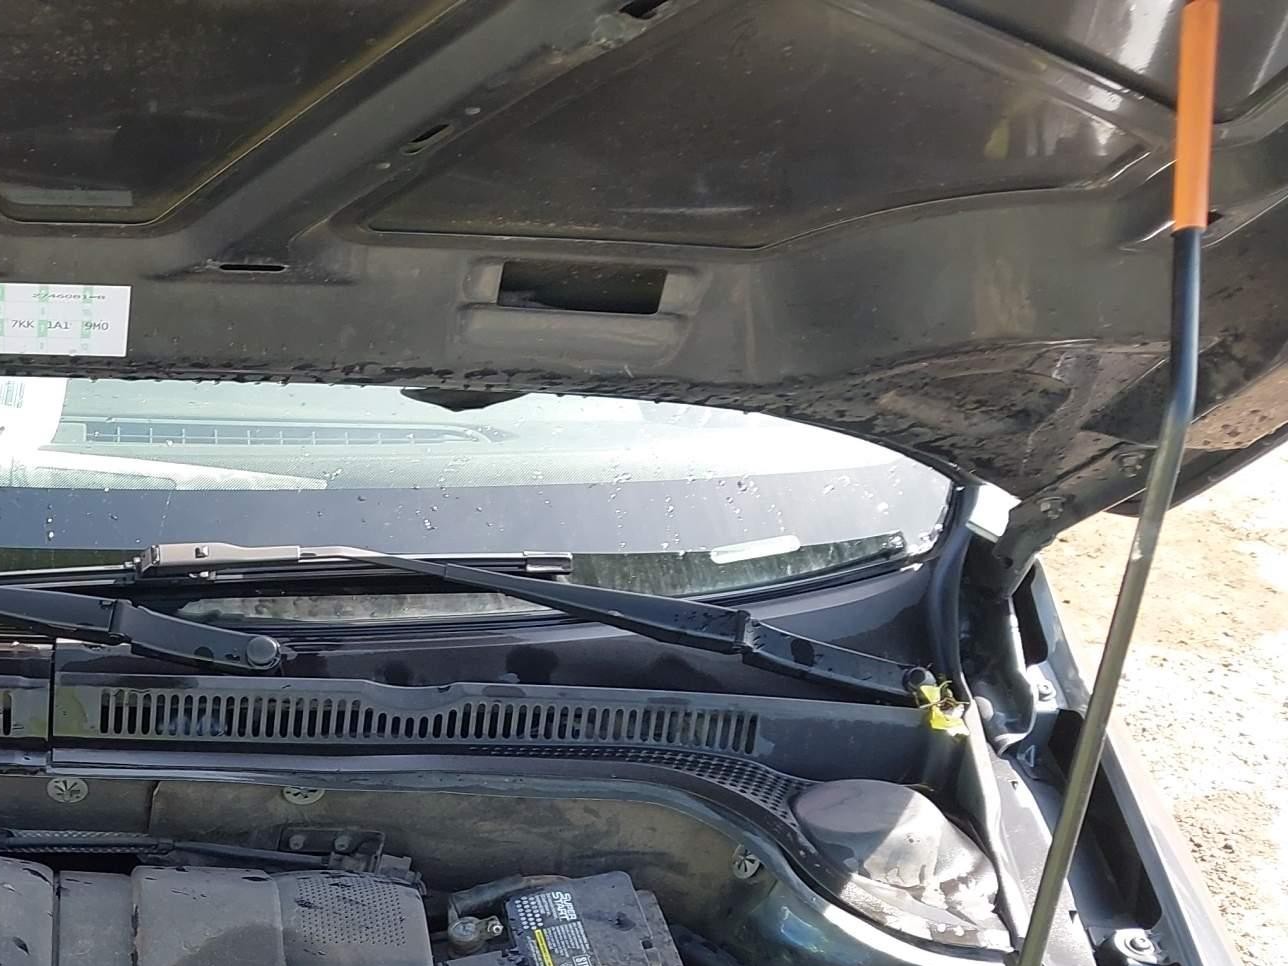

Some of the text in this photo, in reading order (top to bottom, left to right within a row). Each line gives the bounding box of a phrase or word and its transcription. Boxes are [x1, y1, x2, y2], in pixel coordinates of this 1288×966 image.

[12, 319, 34, 329] 7KK
[552, 892, 570, 921] START
[563, 893, 576, 920] SUPER
